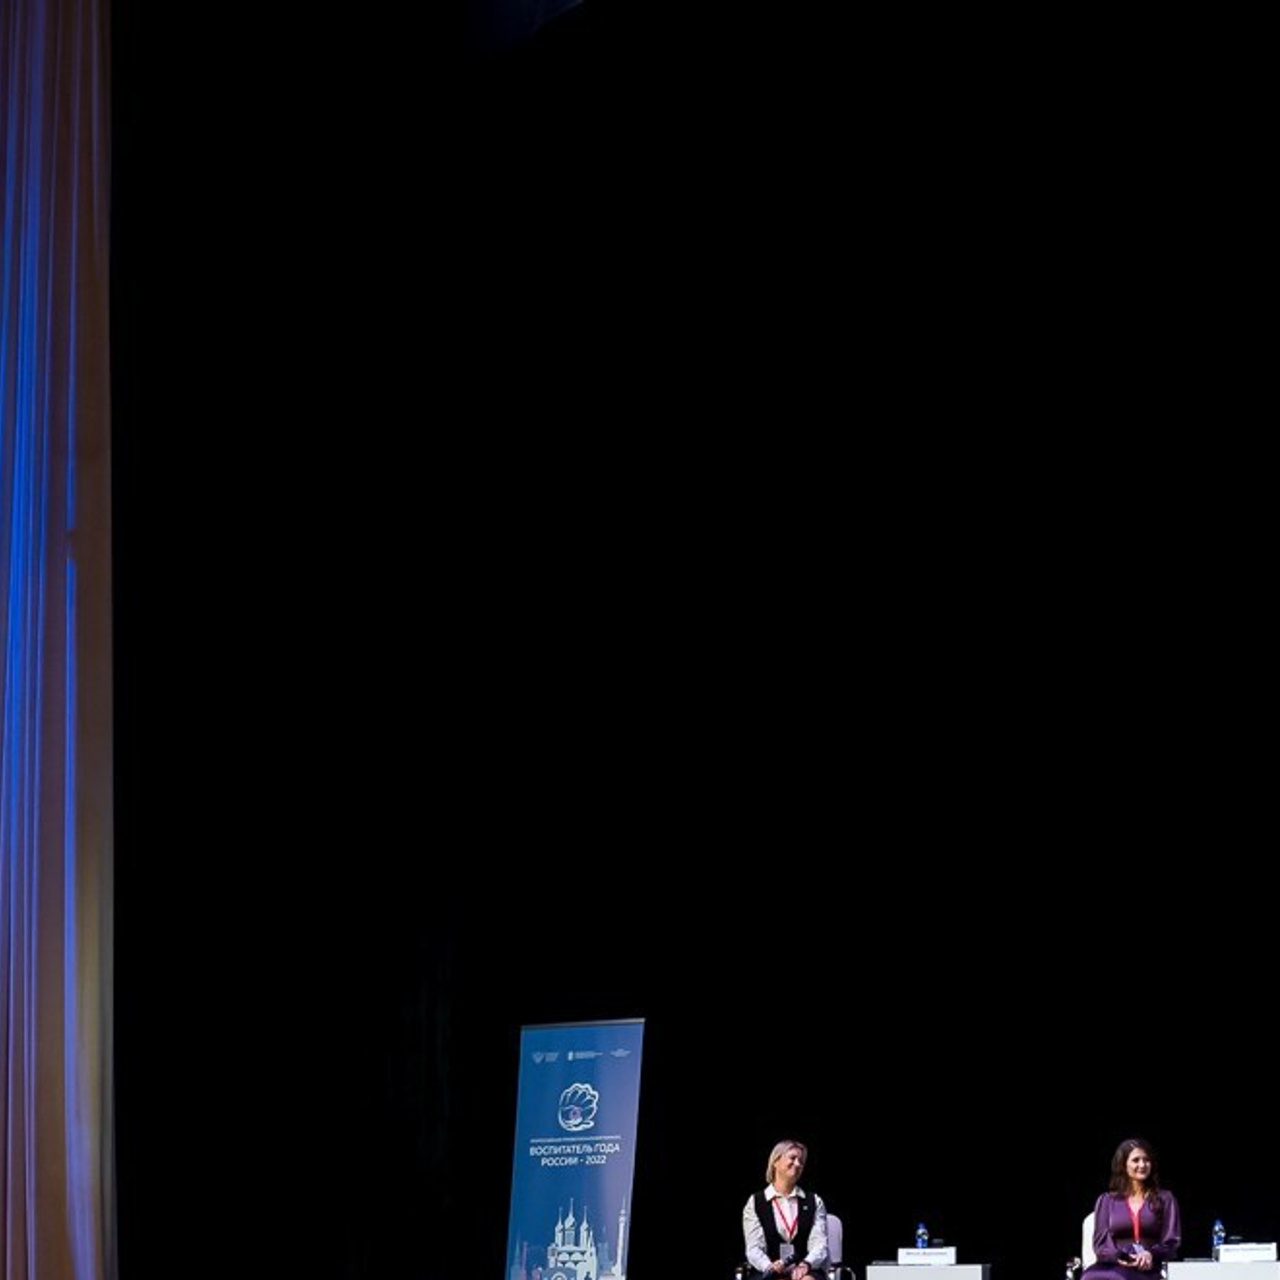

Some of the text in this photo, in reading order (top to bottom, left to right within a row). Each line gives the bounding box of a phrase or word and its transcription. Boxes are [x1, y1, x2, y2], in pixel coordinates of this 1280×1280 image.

[530, 1143, 620, 1156] ВОСПИТАТЕЛЬ ГОДА
[541, 1157, 578, 1167] РОССИИ
[585, 1155, 607, 1165] 2022
